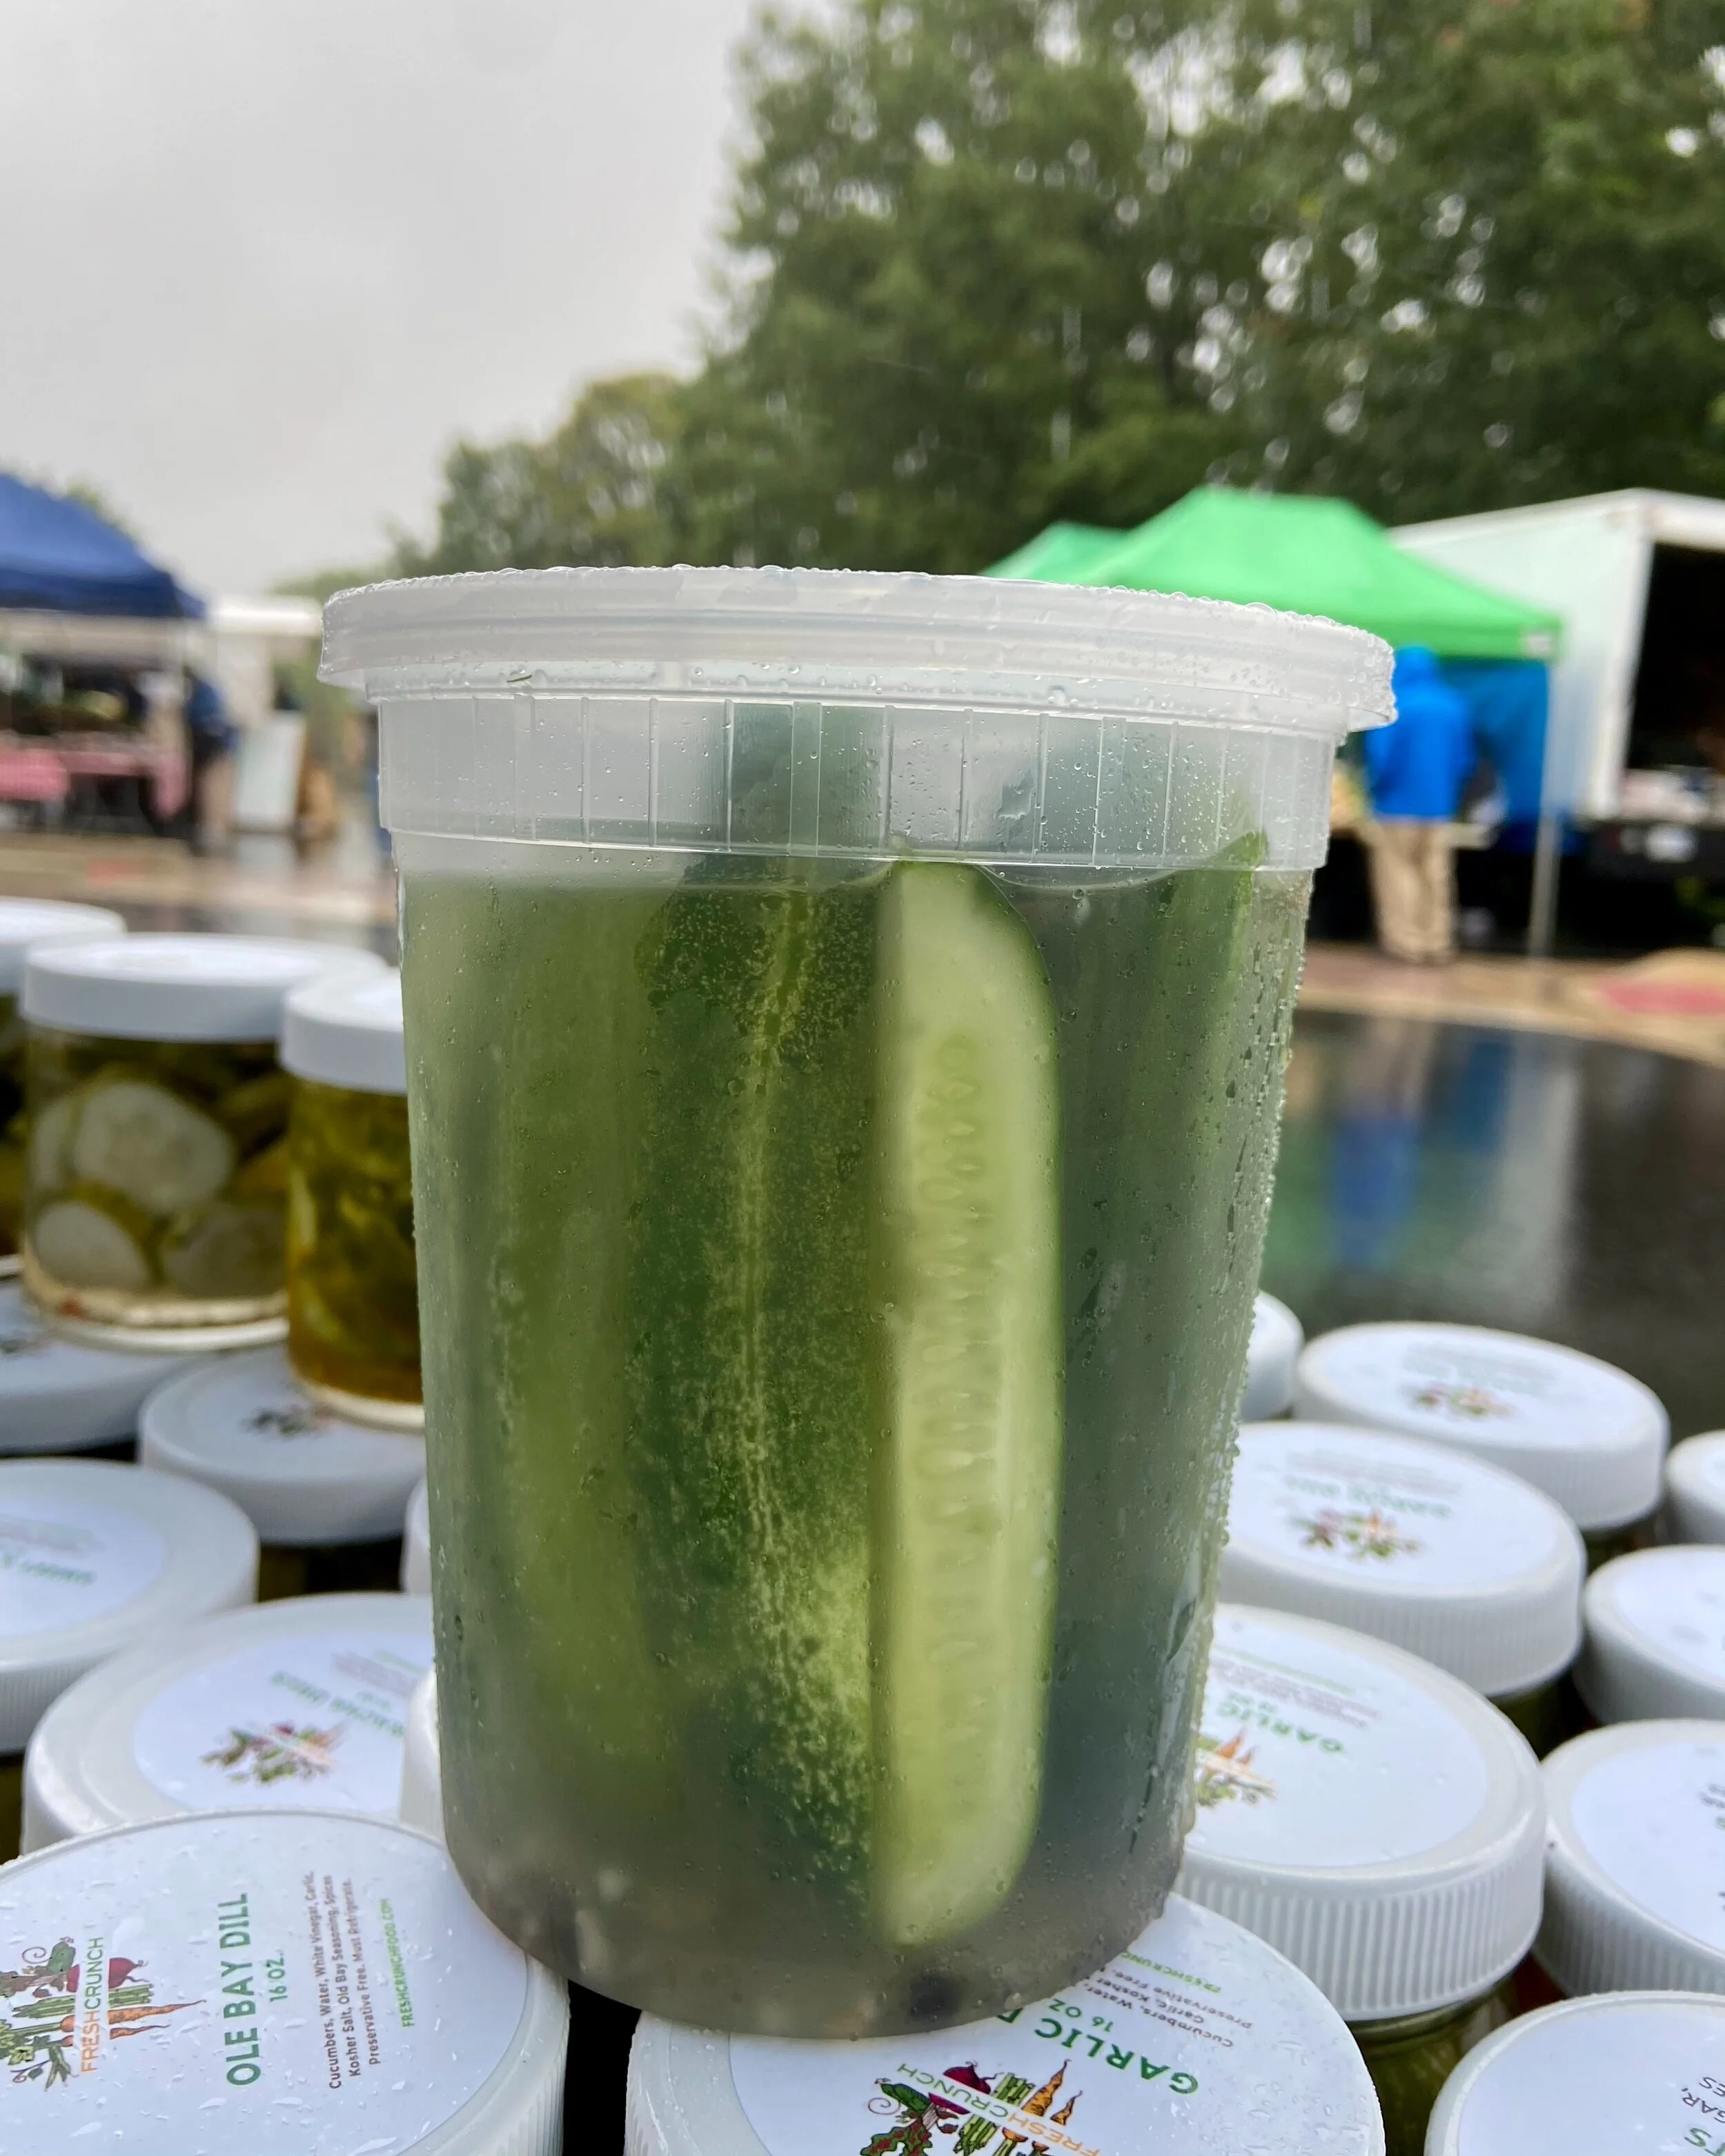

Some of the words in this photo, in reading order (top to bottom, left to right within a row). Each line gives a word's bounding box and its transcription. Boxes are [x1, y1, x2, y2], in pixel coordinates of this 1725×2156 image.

[1217, 1702, 1344, 1753] GARLIC
[217, 1892, 250, 1948] DILL
[313, 1946, 326, 1979] White
[351, 1937, 364, 1962] Must
[221, 1961, 256, 2019] BAY
[268, 1984, 288, 2001] 16
[335, 1964, 348, 1984] Bay
[1096, 1977, 1150, 2001] Kosher
[81, 1937, 103, 2072] FRESHCRUNCH
[319, 1979, 331, 2017] Water,
[337, 1985, 350, 2005] Old
[1048, 1998, 1082, 2019] OZ
[1153, 1986, 1253, 2029] Preservative
[341, 2006, 354, 2034] Salt,
[359, 1993, 381, 2065] Preservative
[1092, 2015, 1114, 2033] 16
[224, 2027, 261, 2086] OLE
[324, 2018, 342, 2089] Cucumbers,
[345, 2036, 361, 2077] Kosher
[1034, 2017, 1199, 2095] GARLIC
[897, 2063, 1101, 2156] FRESHCRUNCH
